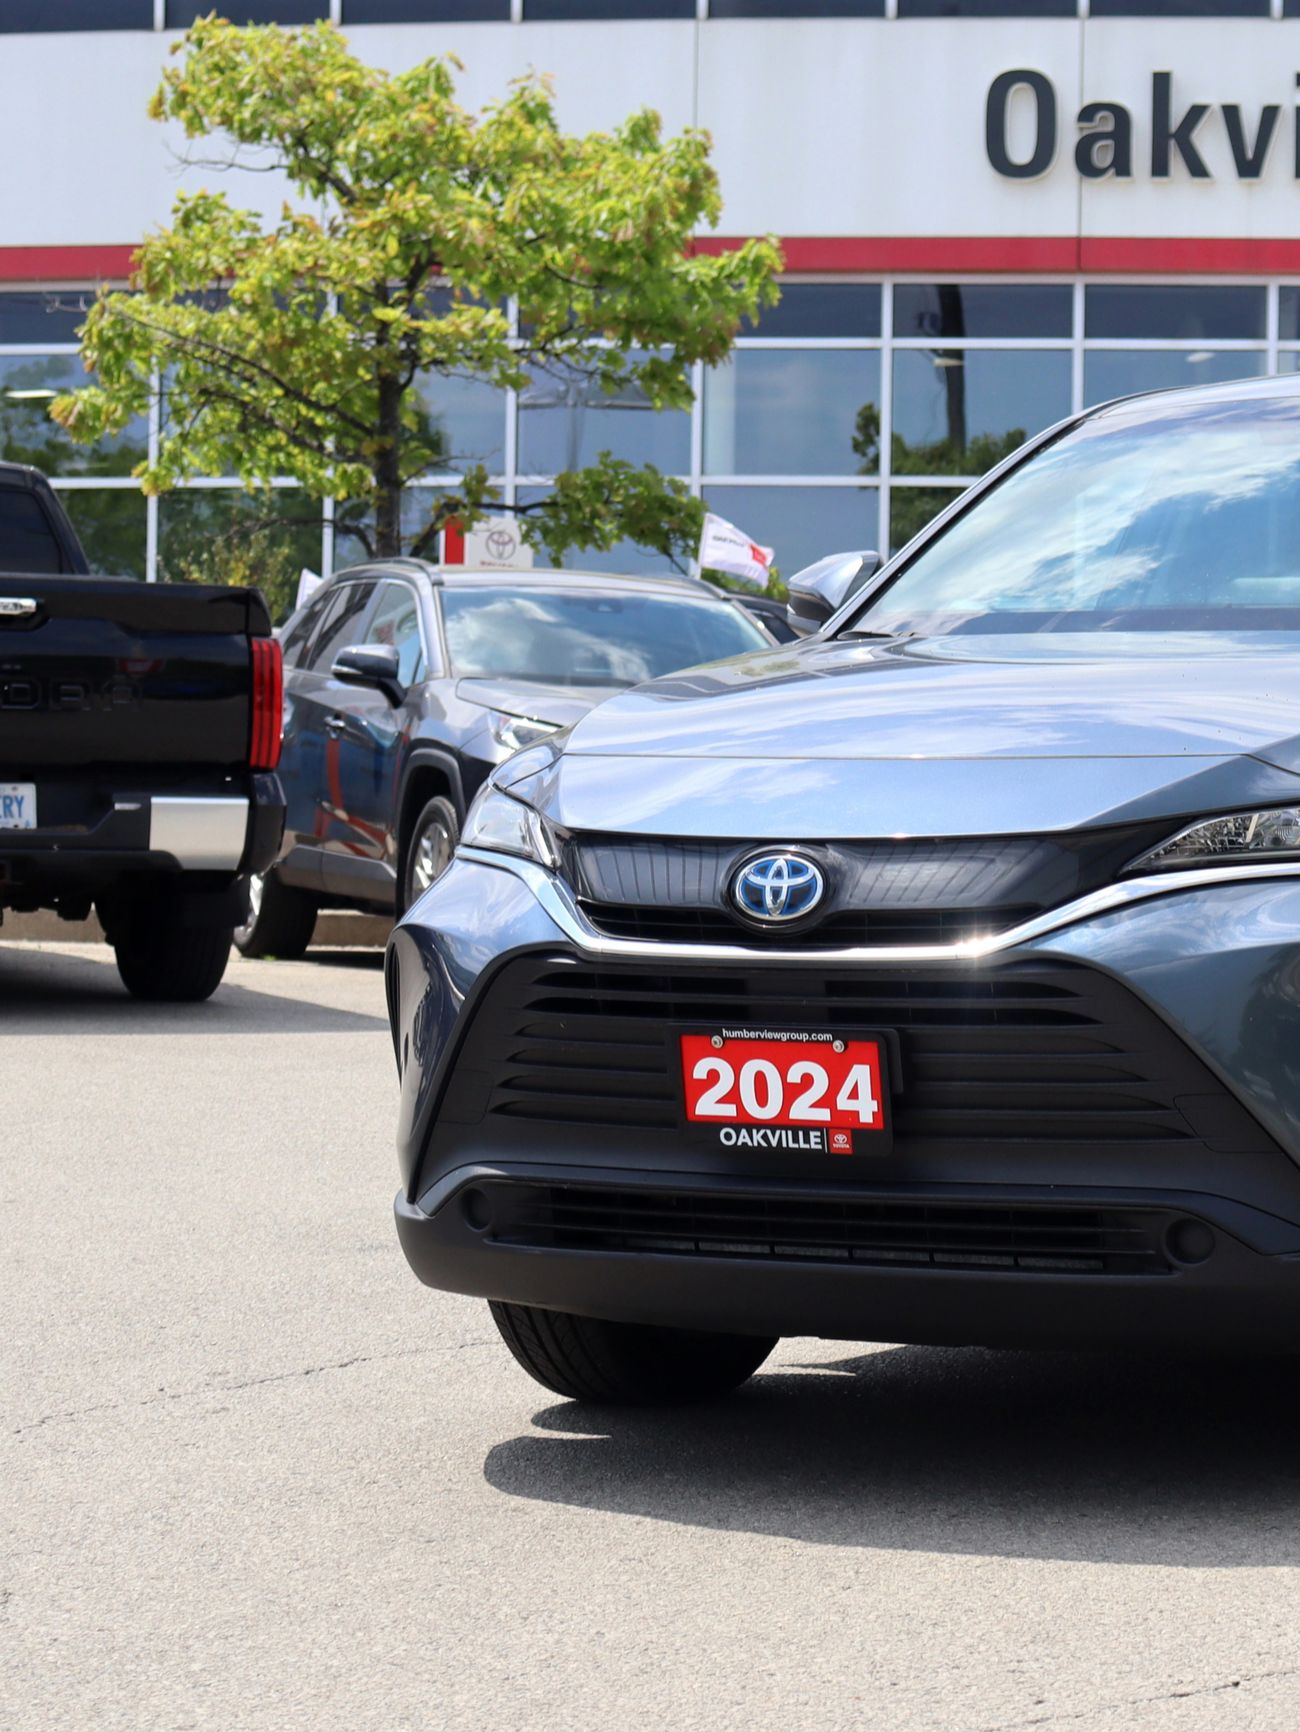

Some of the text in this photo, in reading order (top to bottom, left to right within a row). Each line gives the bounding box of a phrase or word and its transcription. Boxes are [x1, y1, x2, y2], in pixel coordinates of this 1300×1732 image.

[0, 794, 25, 819] RY
[721, 1028, 833, 1042] humberviewgroup.com
[692, 1056, 879, 1124] 2024
[719, 1127, 823, 1150] OAKVILLE
